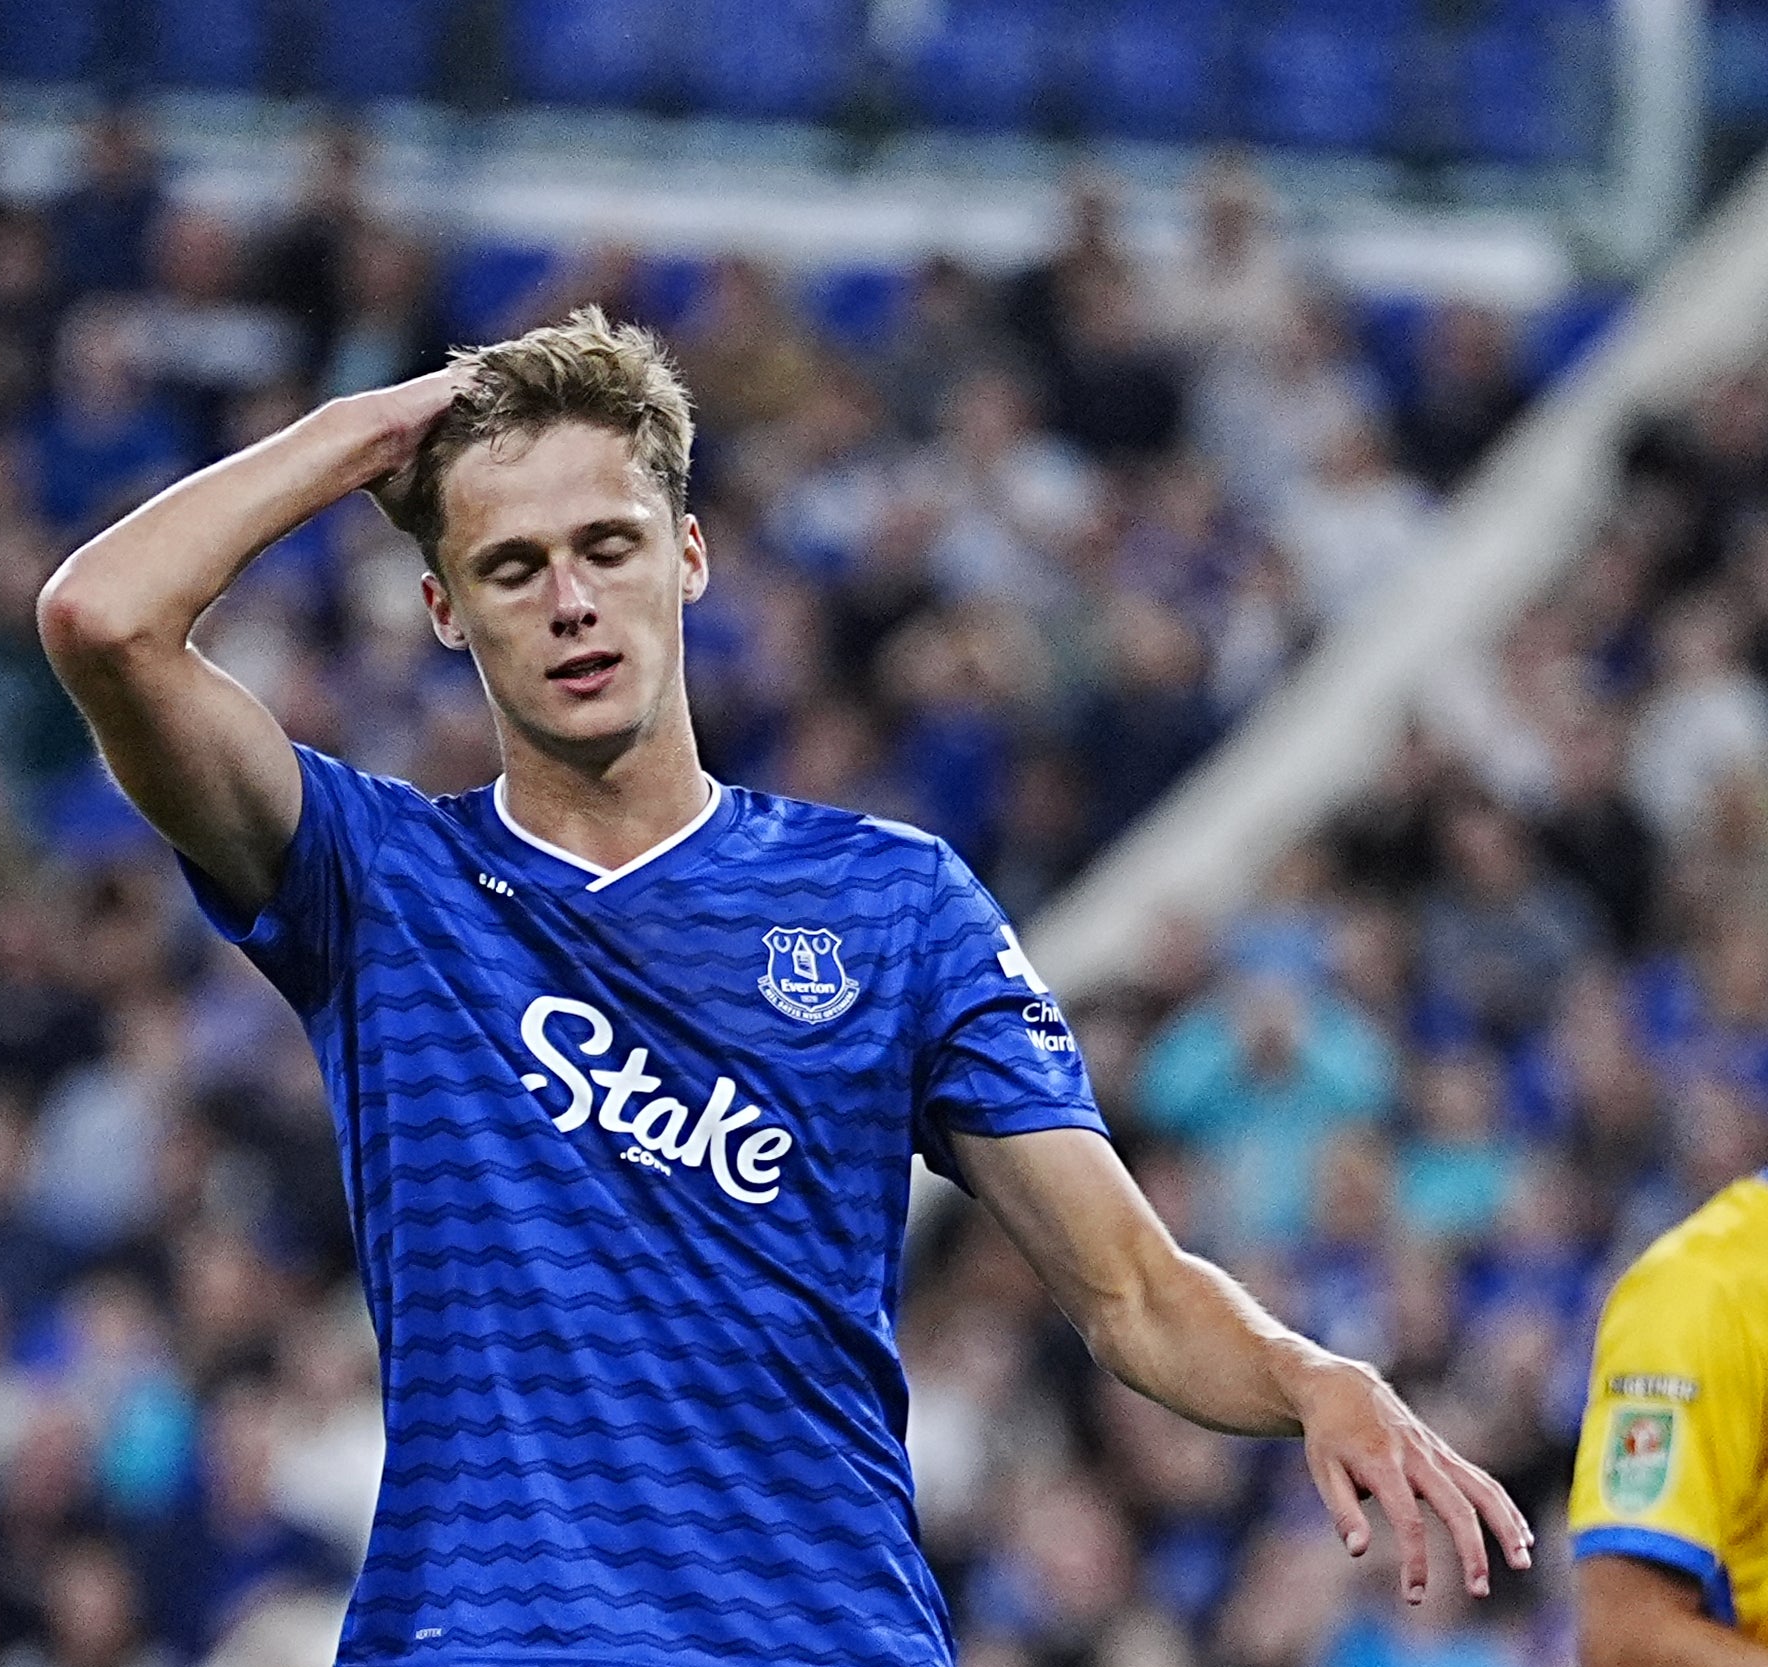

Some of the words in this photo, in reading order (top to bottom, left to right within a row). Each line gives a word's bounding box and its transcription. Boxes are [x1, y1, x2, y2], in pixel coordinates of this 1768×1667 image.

[780, 978, 835, 994] Everton
[1025, 1027, 1077, 1052] Ward
[520, 995, 793, 1204] Stake
[619, 1146, 672, 1177] .com
